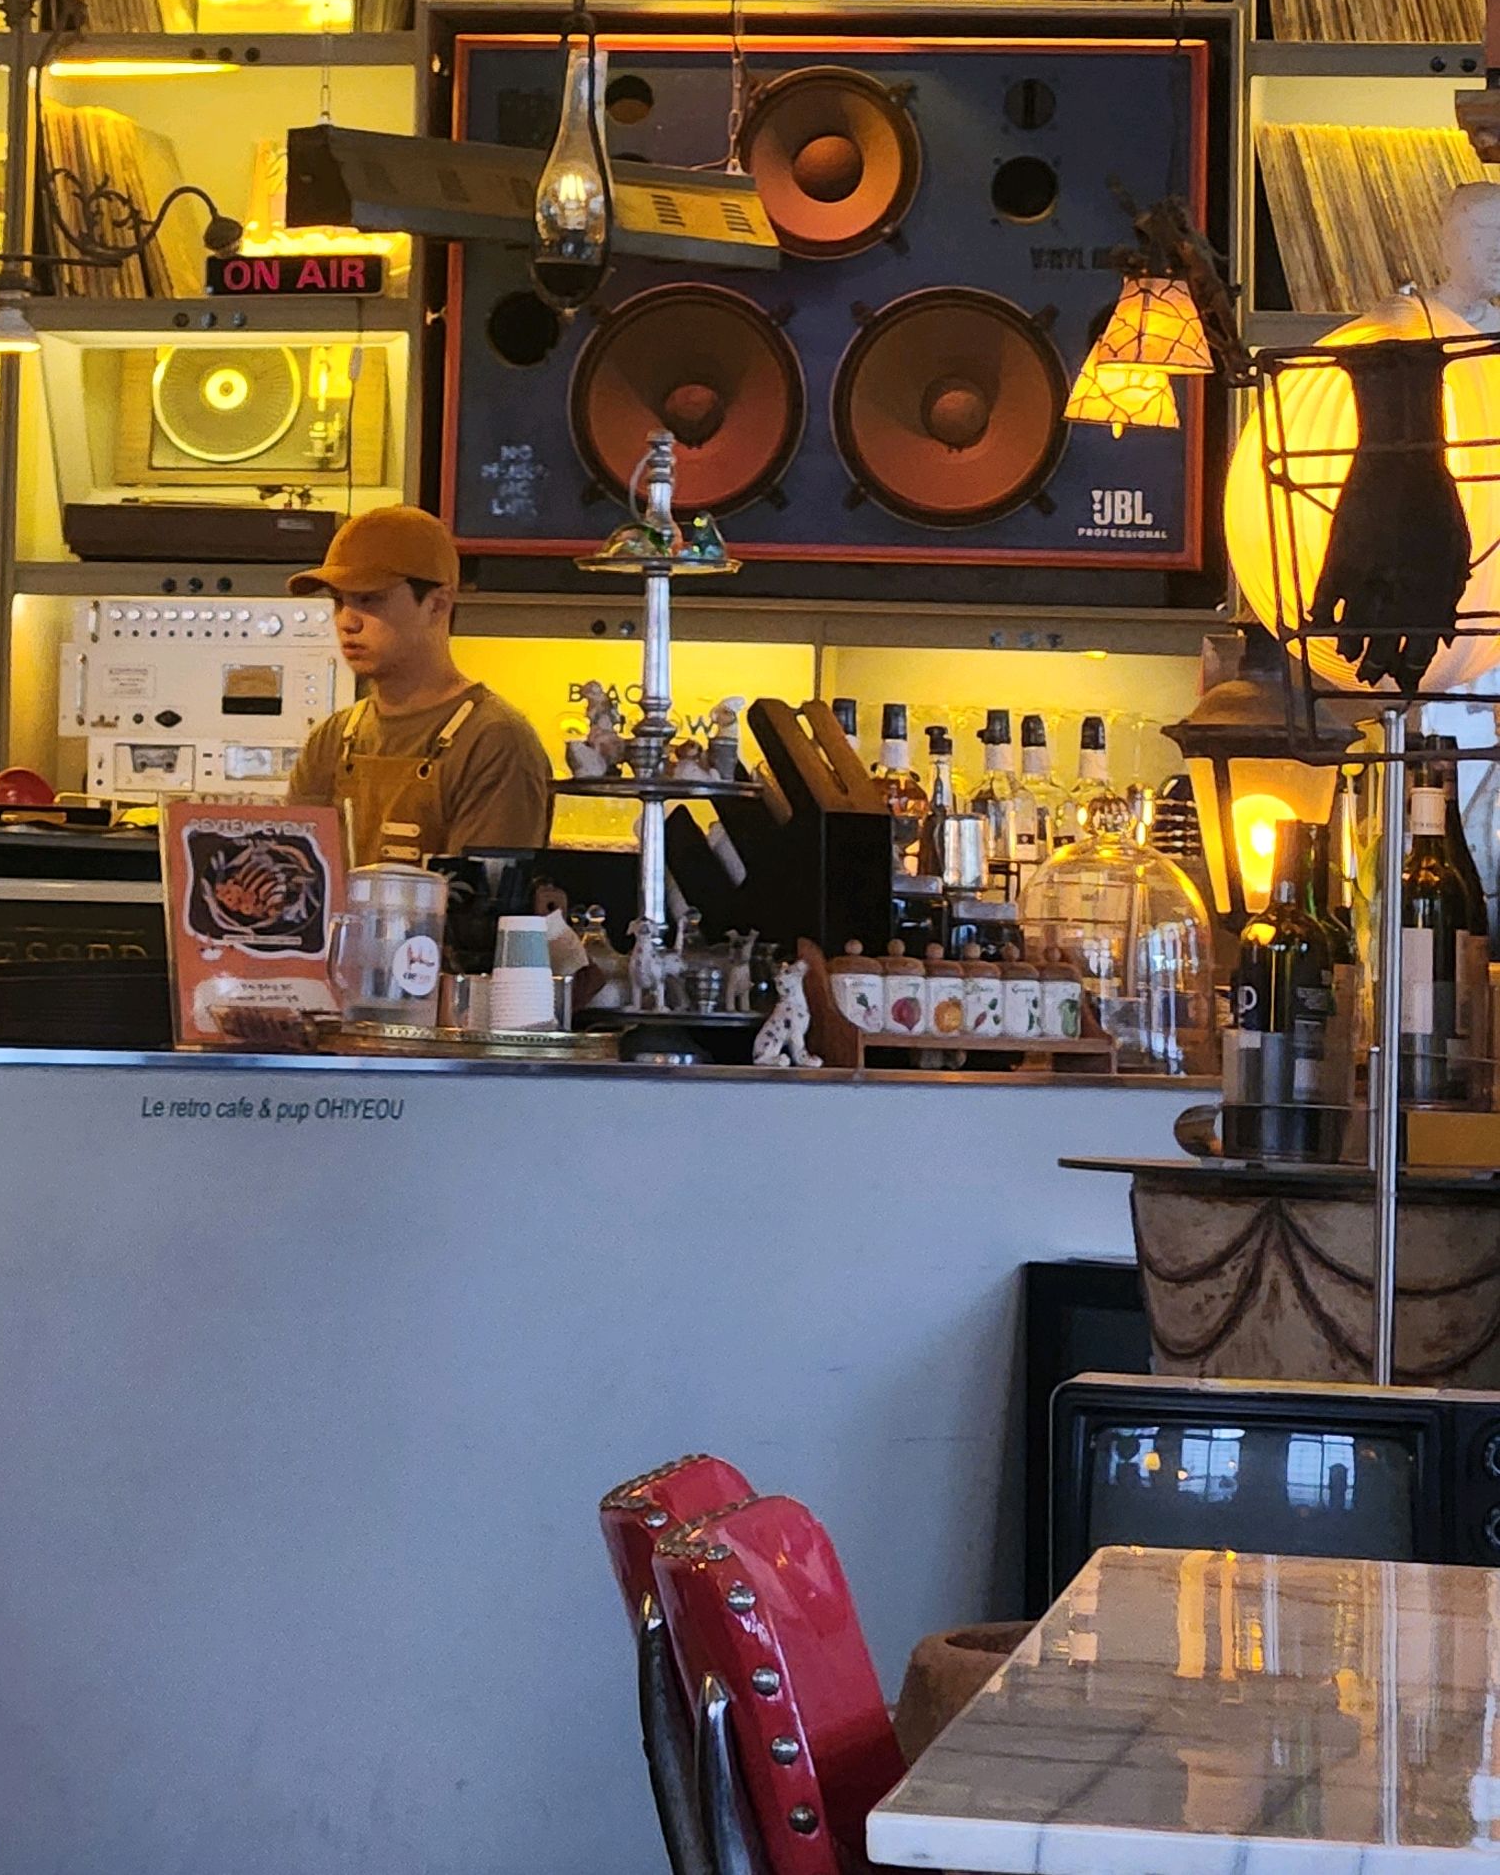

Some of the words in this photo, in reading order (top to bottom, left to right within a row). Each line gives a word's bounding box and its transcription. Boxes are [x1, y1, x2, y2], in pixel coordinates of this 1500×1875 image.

[223, 259, 281, 291] ON
[295, 257, 366, 289] AIR
[1092, 490, 1154, 525] JBL
[1077, 527, 1168, 539] PROFESSIONAL
[141, 1096, 165, 1118] Le
[168, 1097, 211, 1119] retro
[215, 1096, 253, 1119] cafe
[258, 1098, 271, 1119] &
[276, 1102, 310, 1123] pup
